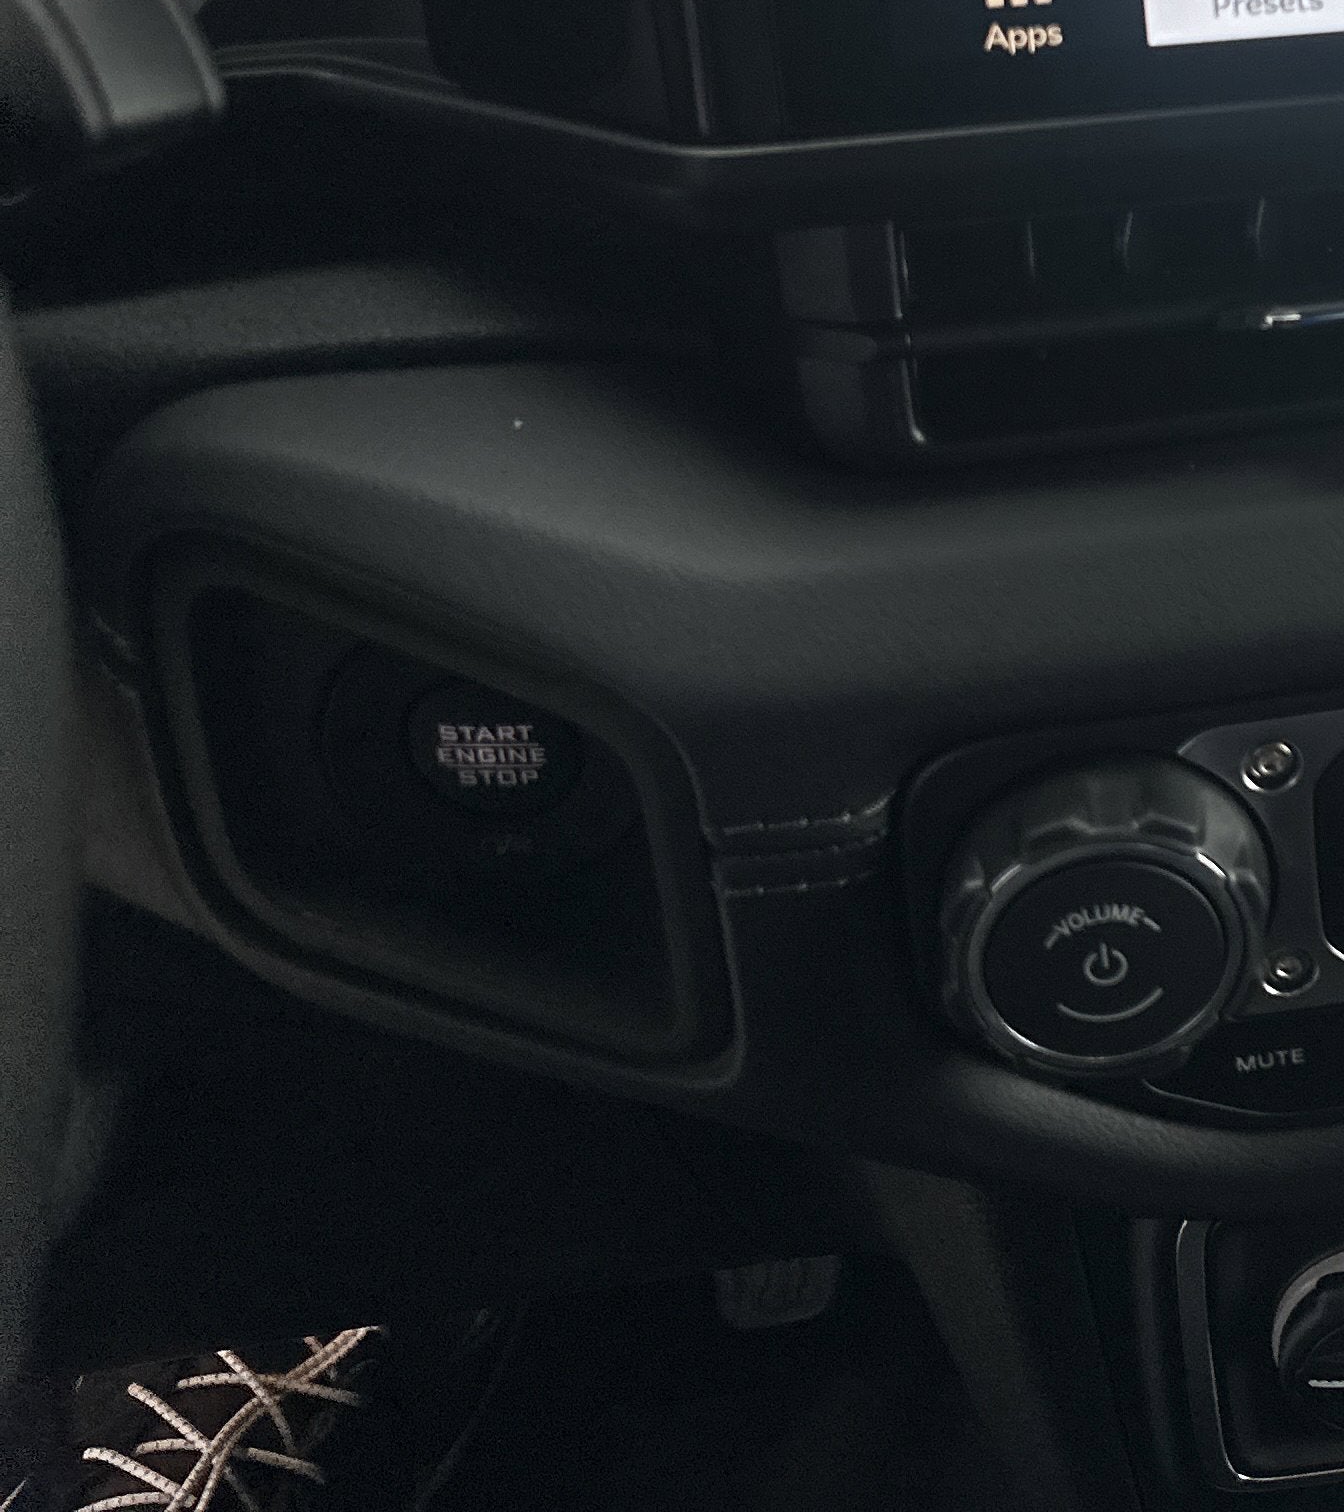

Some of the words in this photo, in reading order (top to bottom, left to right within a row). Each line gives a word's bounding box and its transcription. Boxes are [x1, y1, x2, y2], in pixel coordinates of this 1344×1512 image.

[983, 21, 1063, 55] Apps
[437, 723, 534, 742] START
[437, 746, 548, 764] ENGINE
[458, 768, 539, 785] STOP
[1054, 904, 1146, 939] VOLUME
[1235, 1047, 1306, 1073] MUTE
